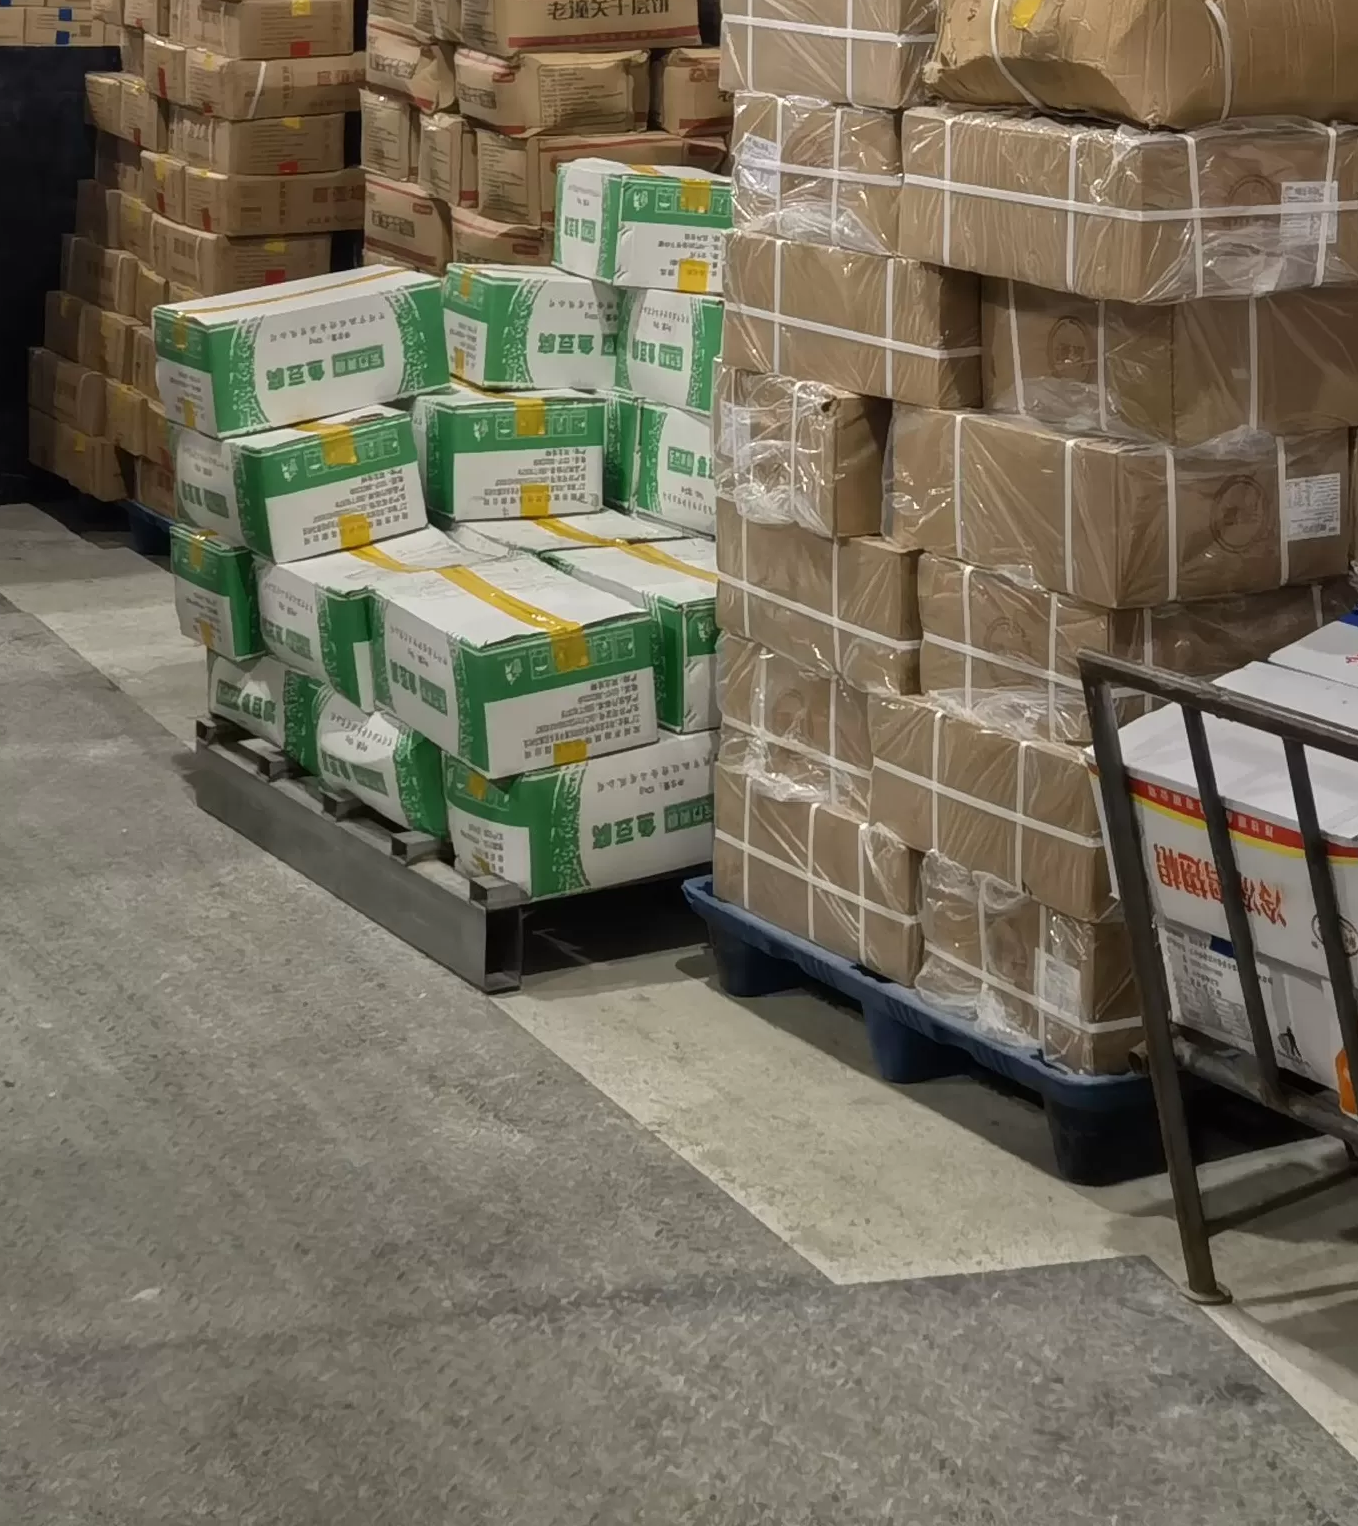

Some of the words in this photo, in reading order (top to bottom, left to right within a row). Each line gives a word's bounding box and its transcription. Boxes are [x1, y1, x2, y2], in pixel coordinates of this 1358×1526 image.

[537, 333, 595, 355] 鱼豆腐
[266, 359, 325, 390] 鱼豆腐
[592, 811, 656, 850] 鱼豆腐
